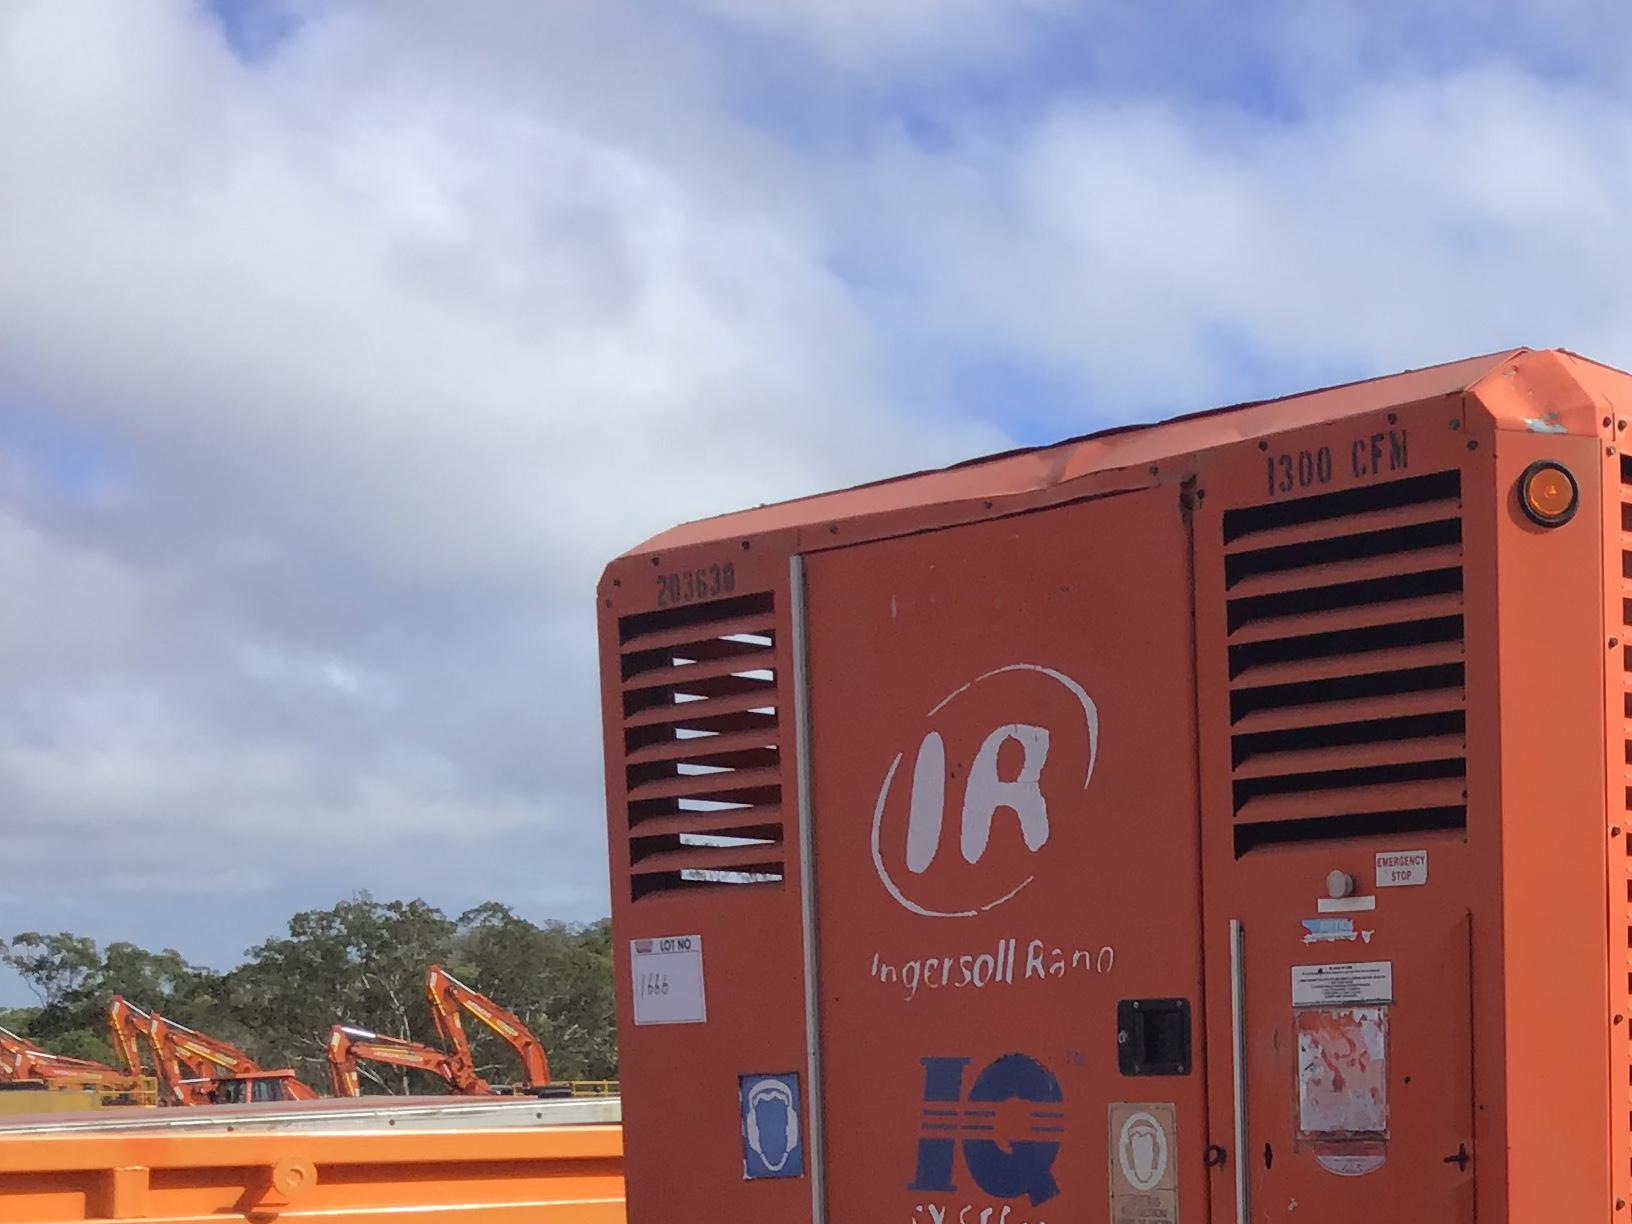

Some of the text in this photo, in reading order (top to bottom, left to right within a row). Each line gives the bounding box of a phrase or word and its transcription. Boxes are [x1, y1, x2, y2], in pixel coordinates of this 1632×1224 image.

[1267, 429, 1408, 497] 1300 CFM
[1377, 855, 1425, 868] EMERGENCY
[1391, 870, 1412, 882] STOP
[660, 937, 692, 952] LOT NO
[871, 938, 1016, 1001] Ingersoll
